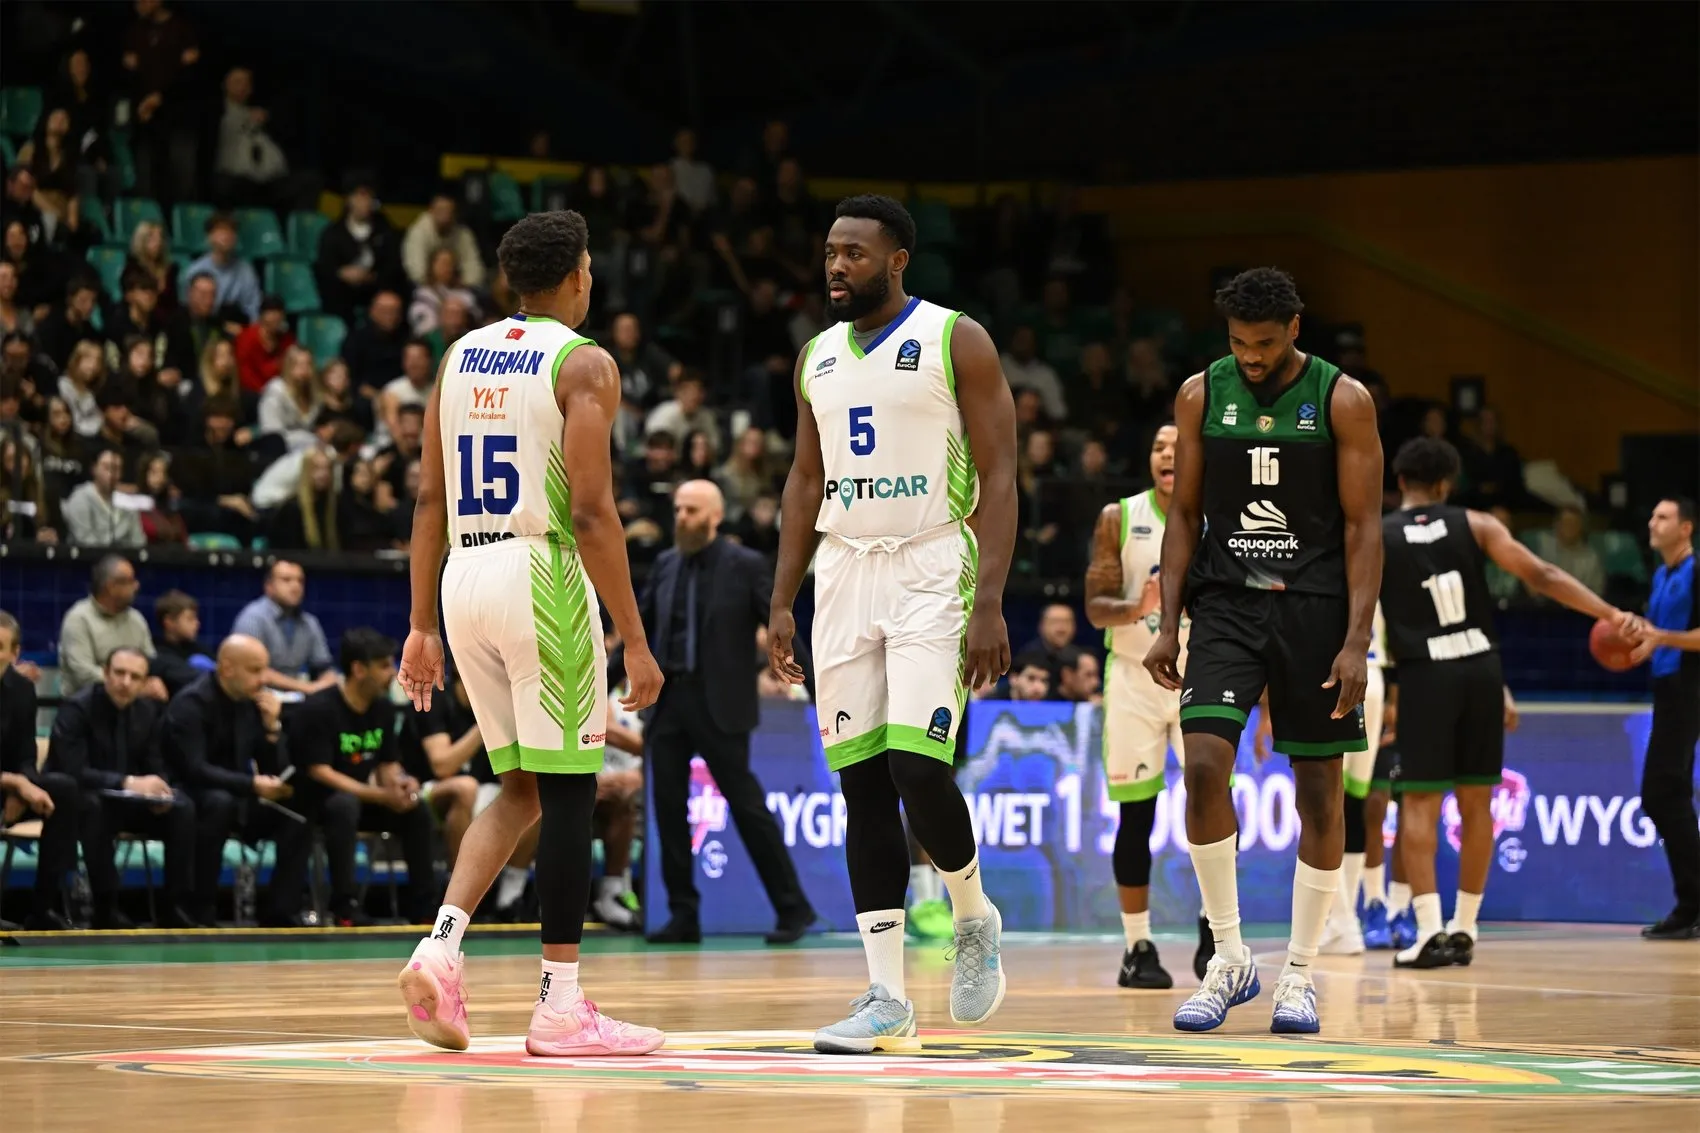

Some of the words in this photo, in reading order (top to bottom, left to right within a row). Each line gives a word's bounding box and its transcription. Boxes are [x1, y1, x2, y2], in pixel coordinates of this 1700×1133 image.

[459, 348, 544, 375] THURMAN
[814, 369, 834, 379] HEAD
[473, 386, 509, 409] YKT
[469, 412, 480, 420] Filo
[480, 412, 506, 420] Kiralama
[849, 405, 875, 457] 5
[457, 434, 520, 517] 15
[1246, 446, 1280, 486] 15
[1228, 536, 1299, 553] aquapark
[1421, 569, 1467, 627] 10
[932, 726, 946, 735] BKT
[765, 791, 848, 848] YG
[434, 914, 457, 942] HEA
[874, 920, 898, 929] NIKE
